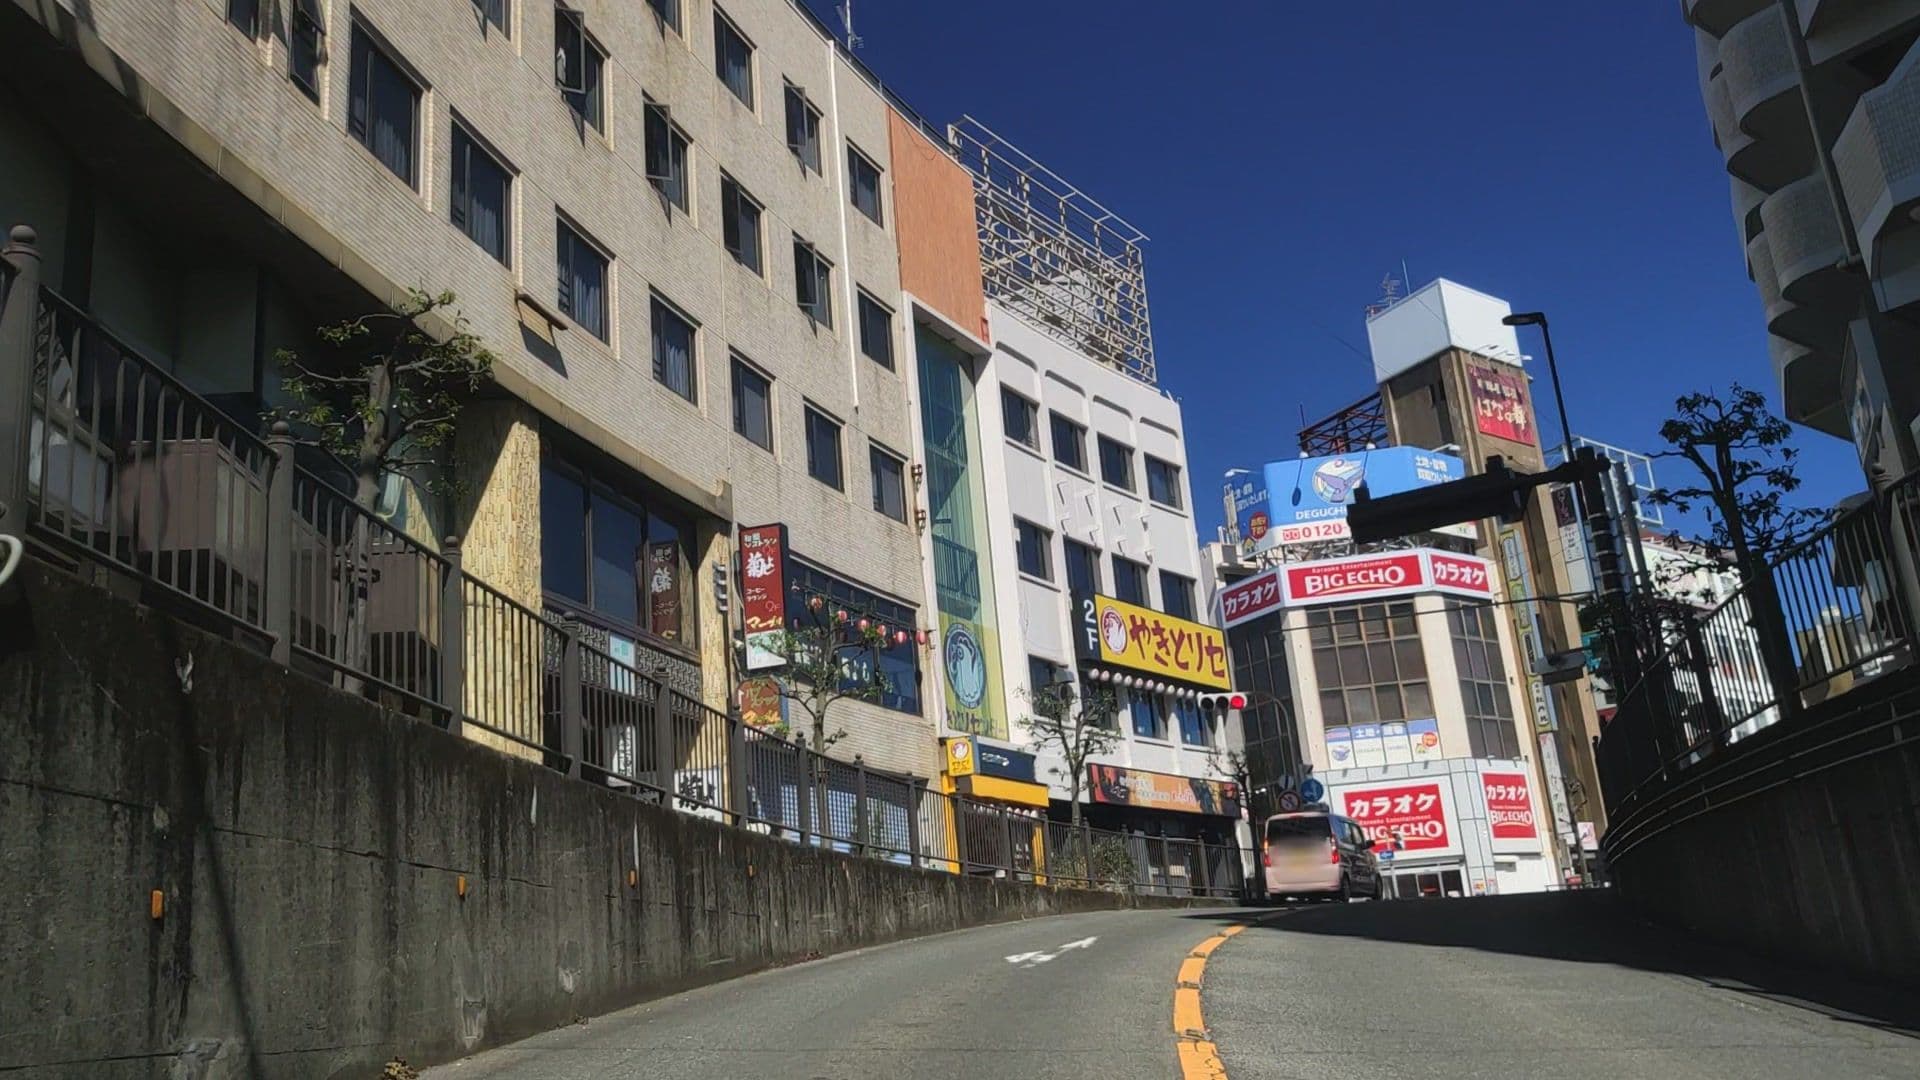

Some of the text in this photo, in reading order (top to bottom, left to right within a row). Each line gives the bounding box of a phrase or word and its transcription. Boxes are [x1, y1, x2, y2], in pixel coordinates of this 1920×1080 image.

[1304, 566, 1406, 596] BIG ECHO
[1434, 561, 1485, 586] カラオケ
[1225, 582, 1276, 617] カラオケ
[1129, 614, 1226, 678] やきとりセ
[1350, 793, 1437, 818] カラオケ
[1486, 785, 1527, 801] カラオケ
[1490, 810, 1533, 825] BIG ECHO
